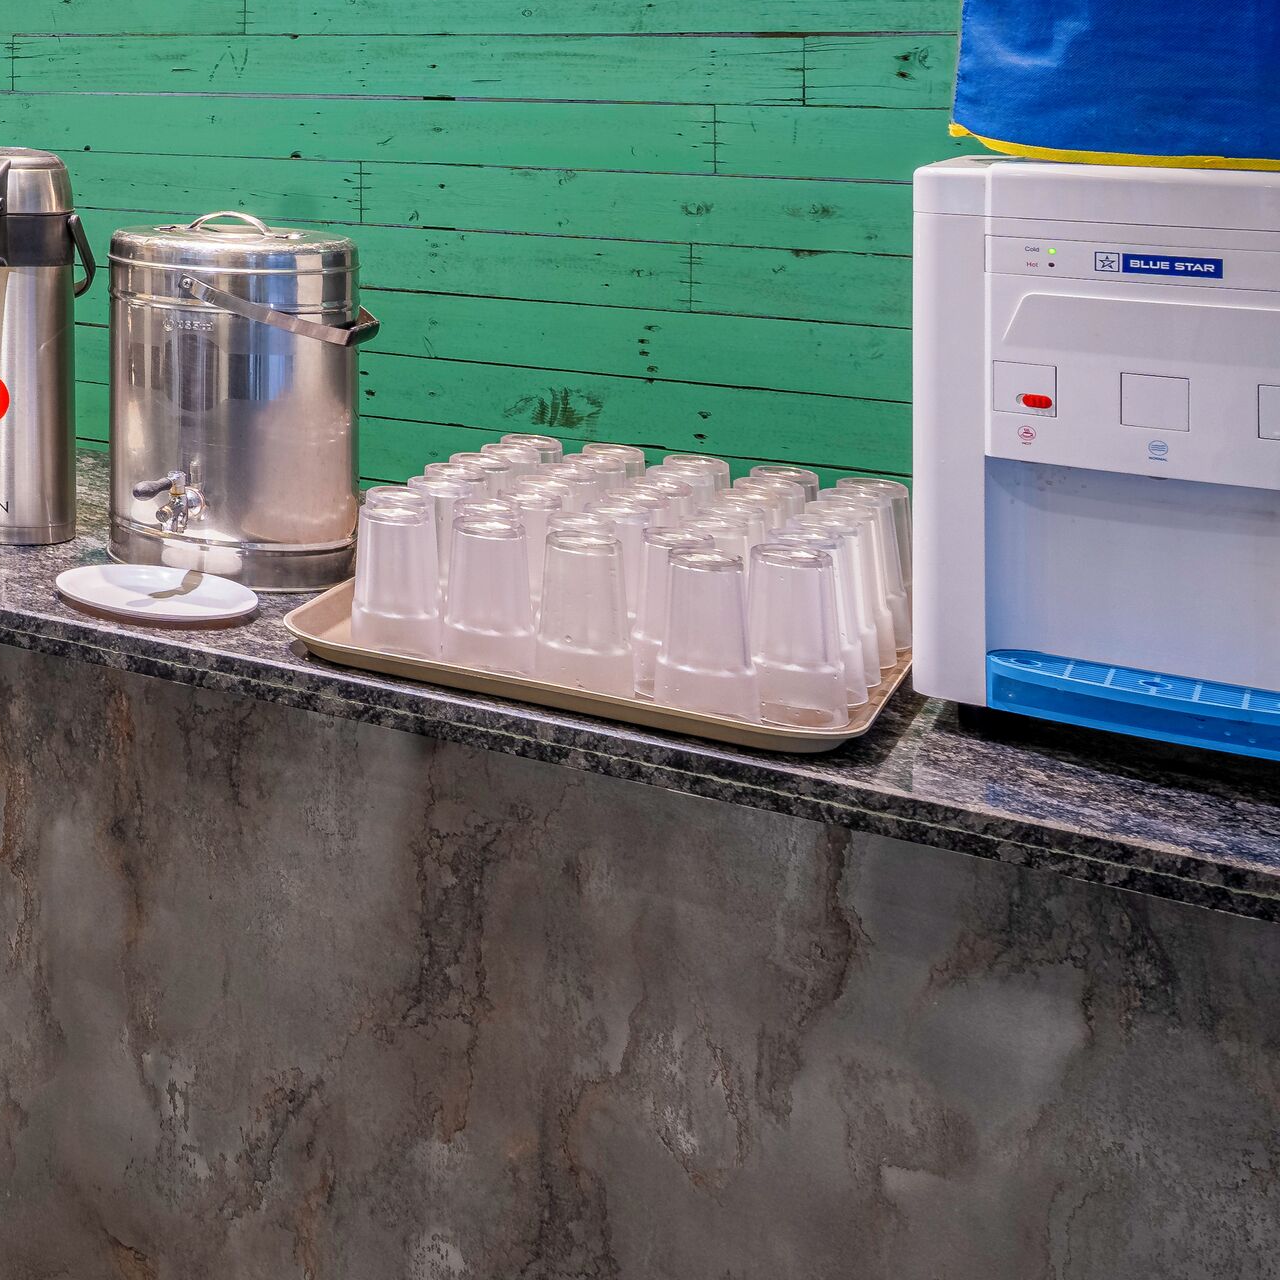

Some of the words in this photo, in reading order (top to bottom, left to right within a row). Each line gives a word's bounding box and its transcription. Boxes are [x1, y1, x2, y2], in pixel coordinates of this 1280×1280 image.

[1024, 245, 1040, 253] Cold
[1129, 259, 1170, 270] BLUE
[1174, 261, 1216, 273] STAR
